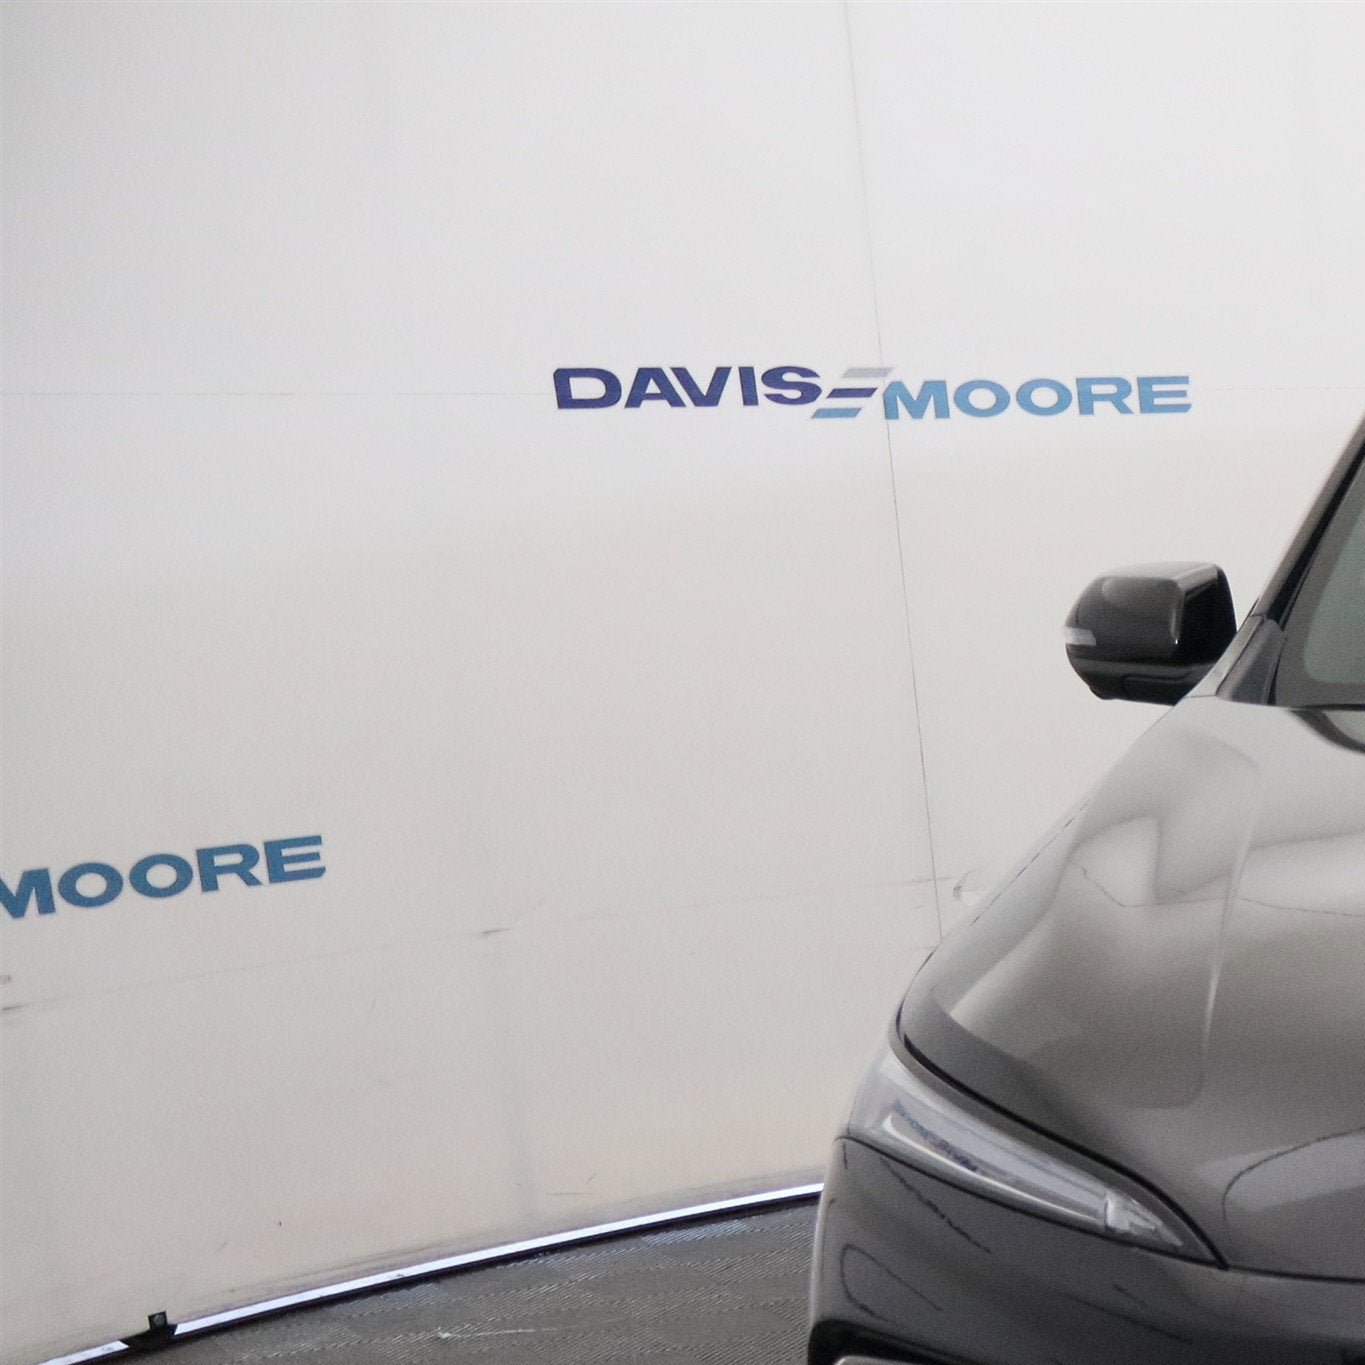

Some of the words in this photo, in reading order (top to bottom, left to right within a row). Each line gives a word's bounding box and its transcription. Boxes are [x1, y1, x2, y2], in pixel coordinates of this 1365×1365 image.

[552, 365, 823, 410] DAVIS
[882, 374, 1193, 421] MOORE
[0, 834, 327, 920] MOORE
